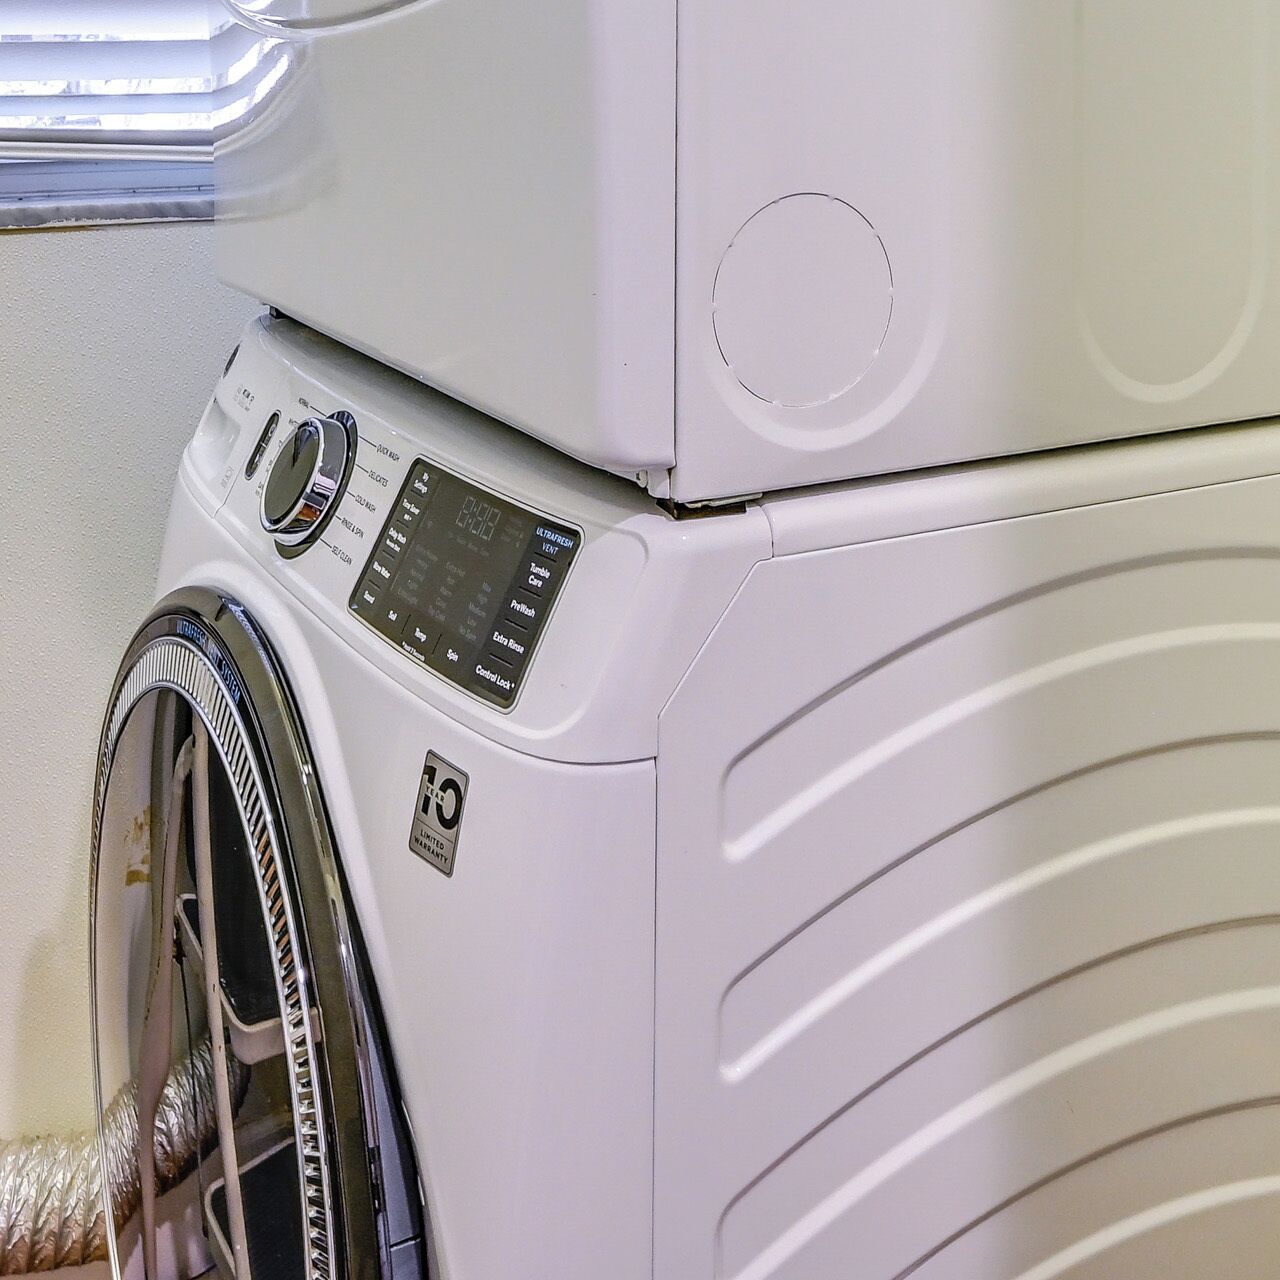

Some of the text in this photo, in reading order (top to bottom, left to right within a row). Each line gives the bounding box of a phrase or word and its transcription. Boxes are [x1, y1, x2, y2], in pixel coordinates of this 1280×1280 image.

[387, 449, 401, 463] WASH
[368, 469, 389, 488] DELICATES
[355, 494, 377, 514] COLD WASH
[355, 525, 364, 539] SPIN
[535, 526, 575, 549] ULTRAFRESH
[331, 545, 353, 566] SELF CLEAN
[542, 541, 559, 556] VENT
[529, 562, 551, 580] Tumble
[528, 574, 543, 588] Care
[510, 599, 536, 619] PreWash
[414, 627, 427, 642] Temp
[492, 631, 525, 654] Extra Rinse
[446, 649, 459, 662] Spin
[222, 660, 241, 704] SYSTEM
[475, 664, 497, 683] Control
[421, 765, 463, 830] 10
[425, 784, 445, 802] YEAR
[420, 829, 445, 850] LIMITED
[414, 835, 449, 864] WARRANTY
